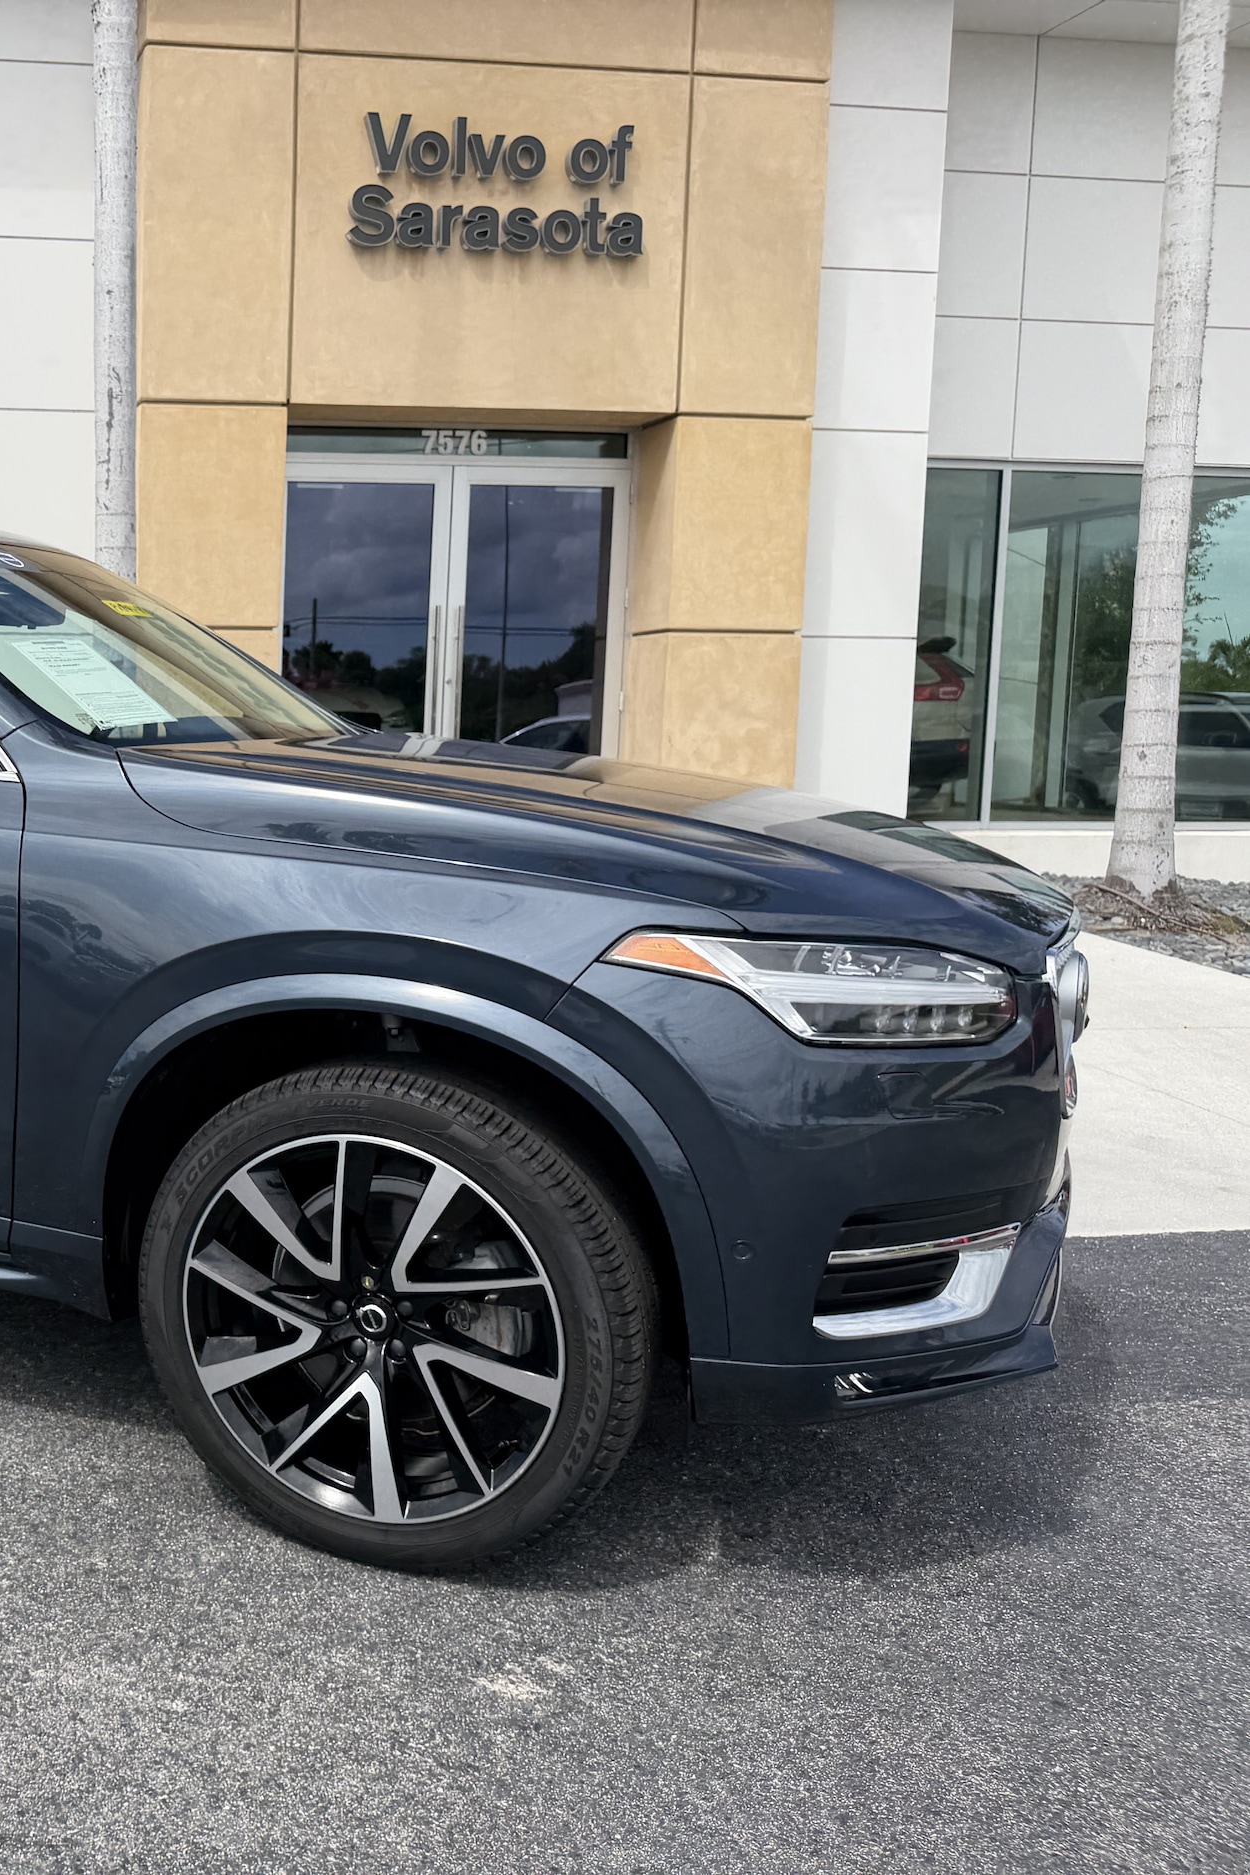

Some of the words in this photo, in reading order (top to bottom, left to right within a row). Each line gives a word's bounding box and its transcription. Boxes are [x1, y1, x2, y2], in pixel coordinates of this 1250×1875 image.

[364, 111, 547, 181] Volvo
[565, 124, 635, 185] of
[346, 184, 644, 257] Sarasota
[421, 429, 487, 456] 7576
